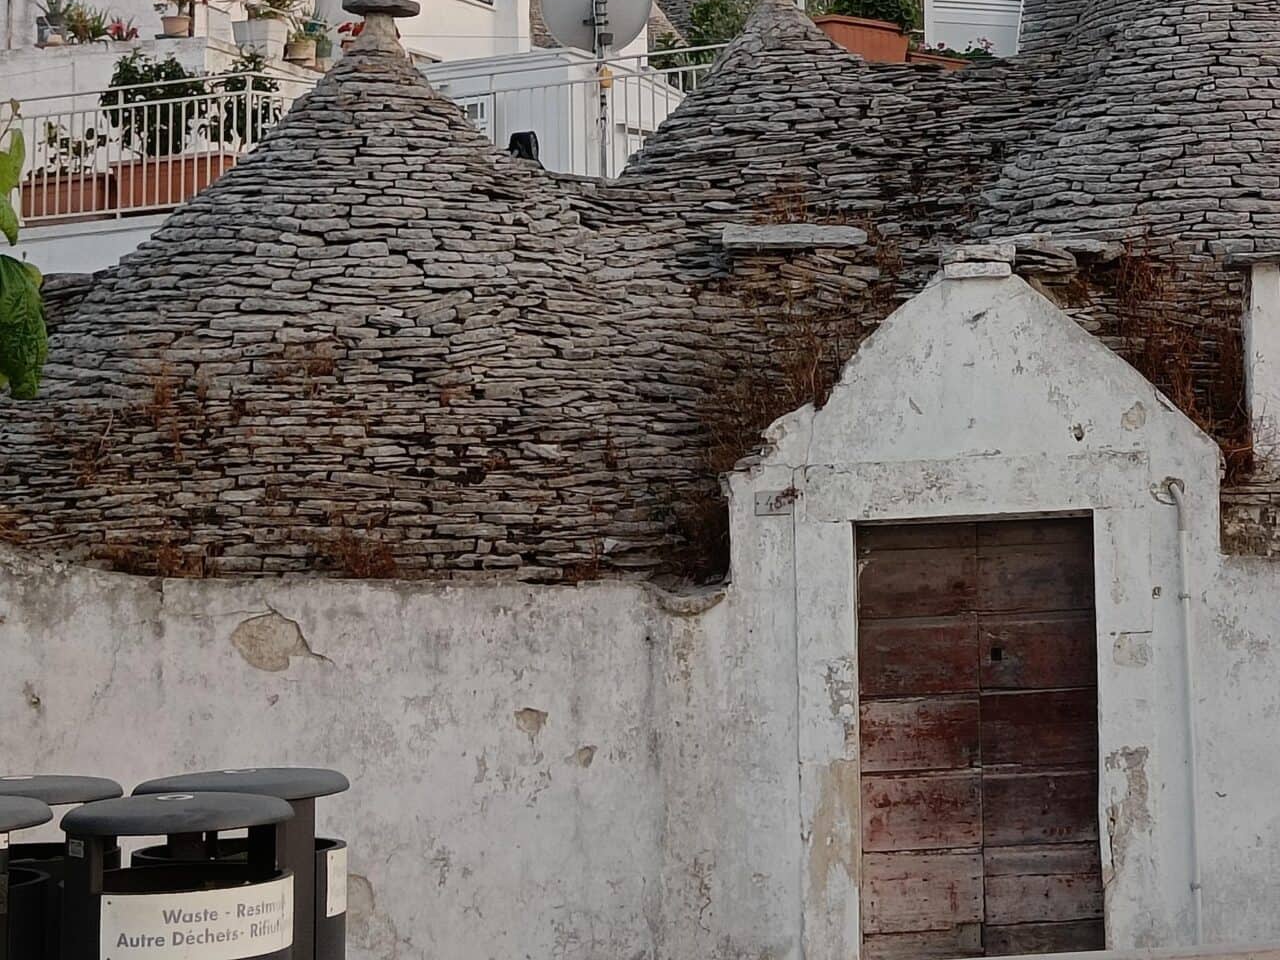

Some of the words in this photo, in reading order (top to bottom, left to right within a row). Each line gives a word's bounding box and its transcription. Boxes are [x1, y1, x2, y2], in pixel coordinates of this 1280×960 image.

[162, 907, 218, 925] Waste
[116, 932, 166, 948] Autre
[250, 919, 281, 939] Rifiut
